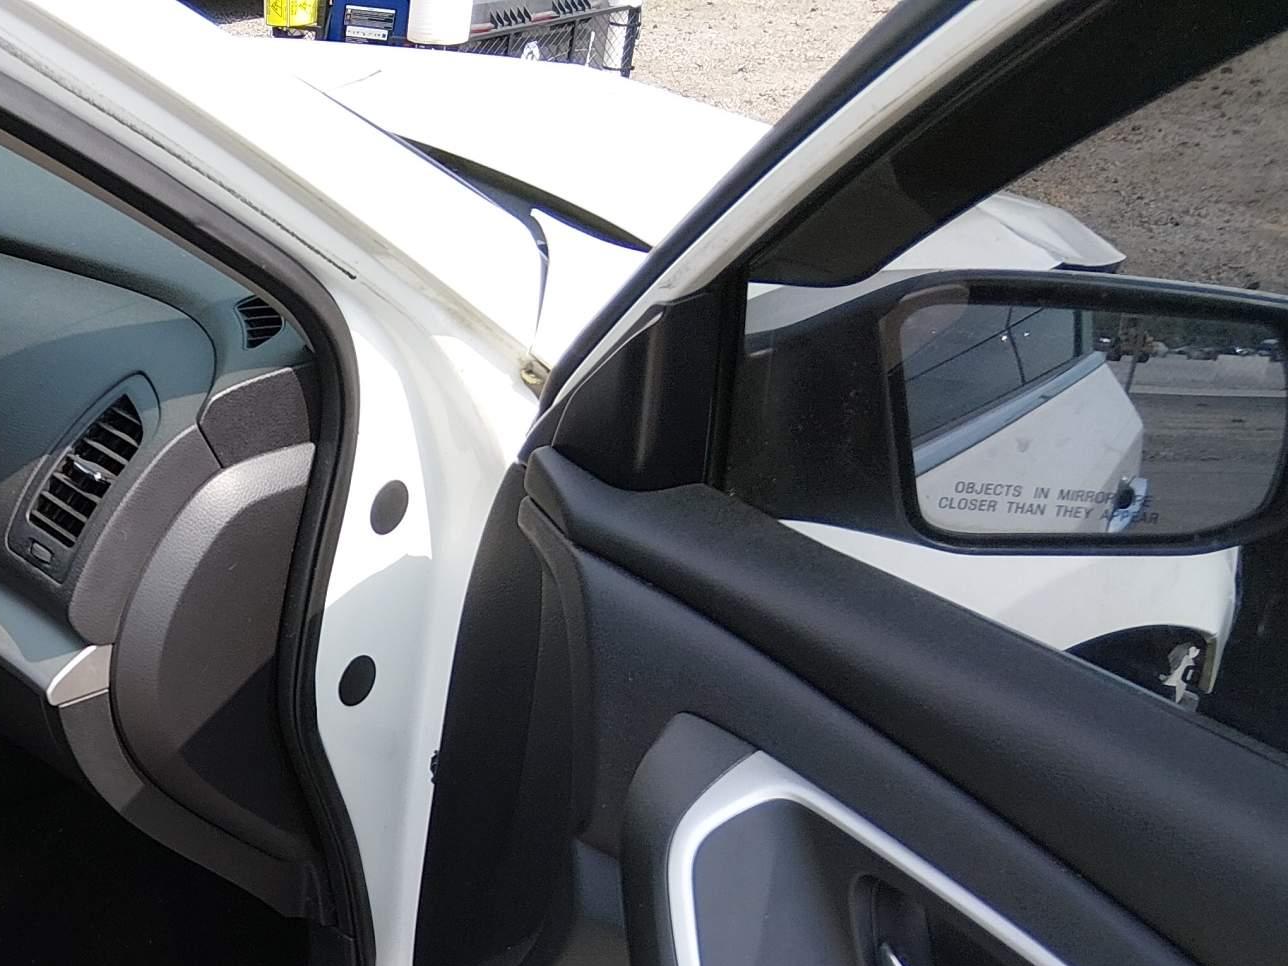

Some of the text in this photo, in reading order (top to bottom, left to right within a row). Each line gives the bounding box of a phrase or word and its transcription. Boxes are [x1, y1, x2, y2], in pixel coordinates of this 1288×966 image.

[955, 481, 1023, 497] OBJECTS
[1033, 487, 1050, 499] IN
[938, 496, 1160, 524] CLOSER THAN THEY APPEAR
